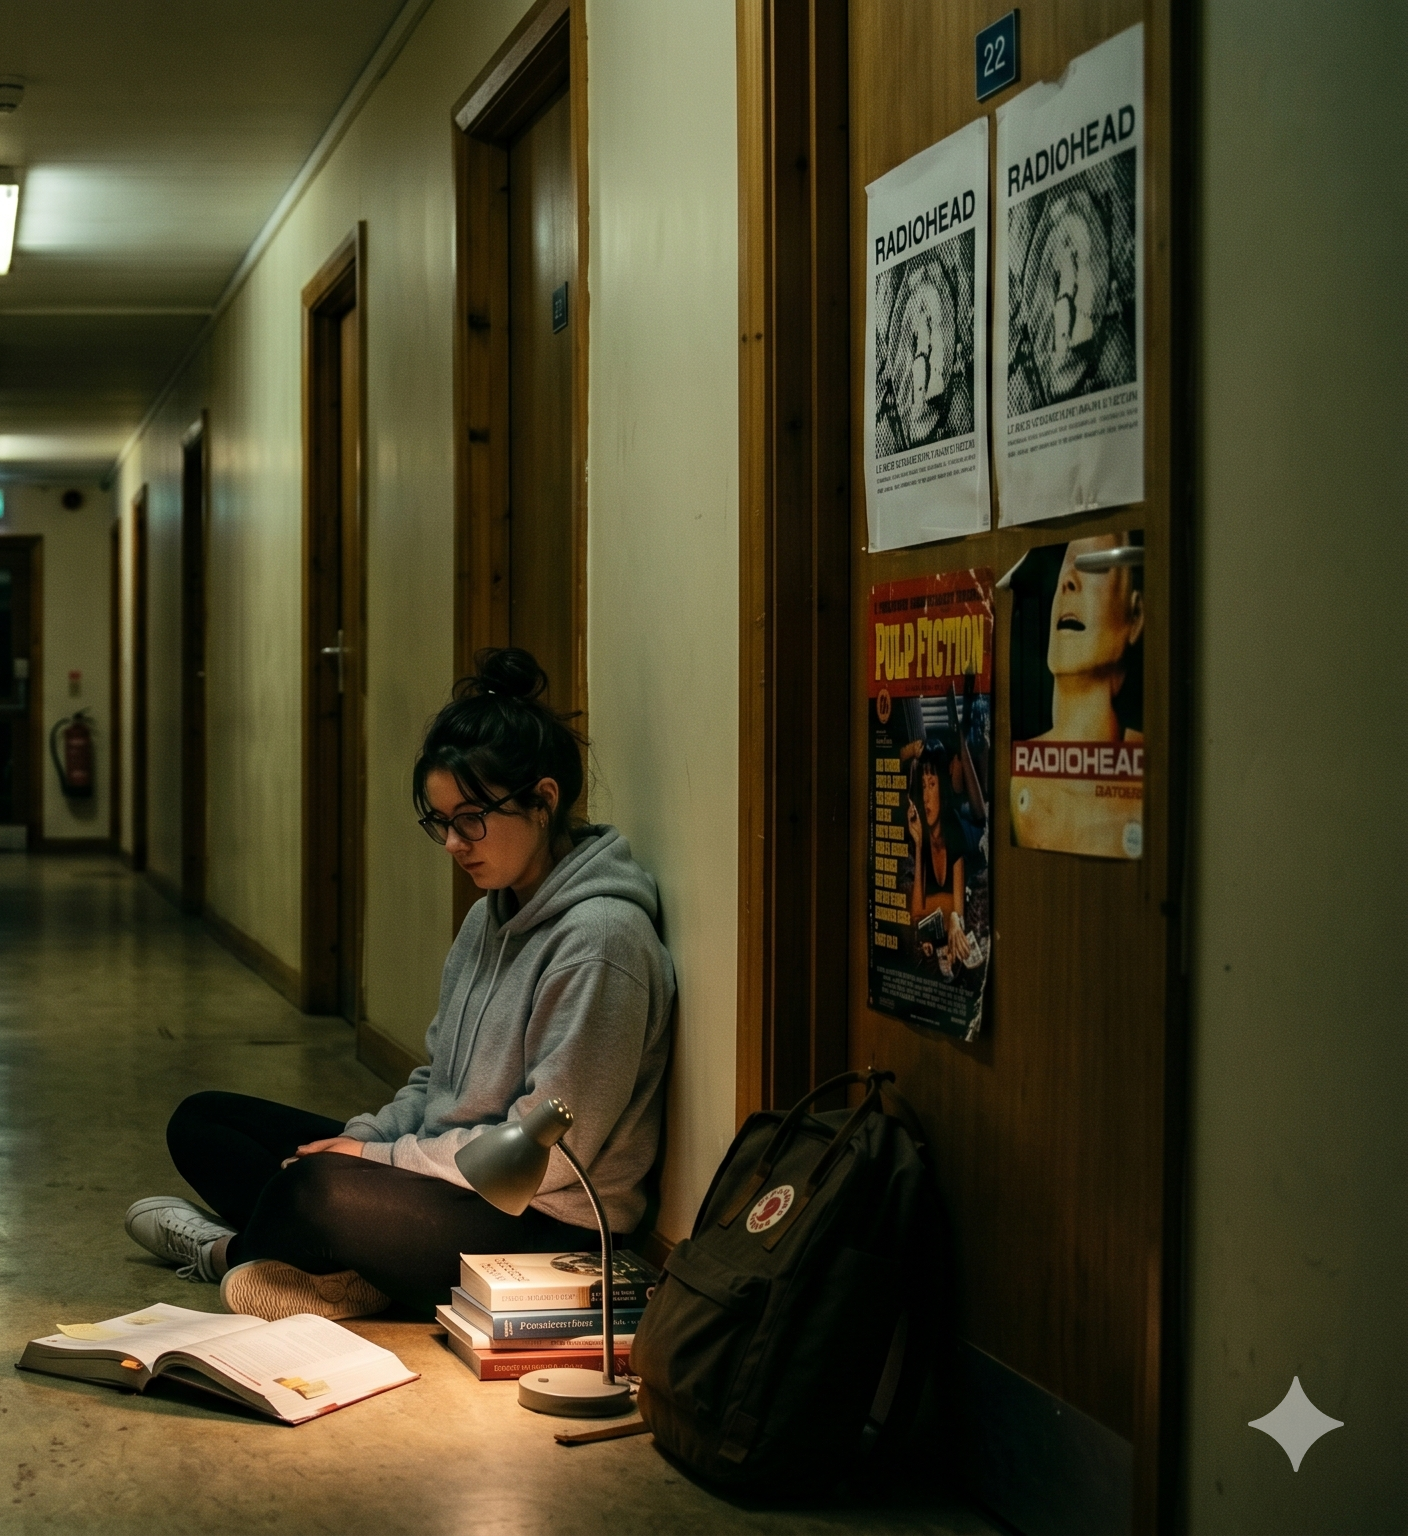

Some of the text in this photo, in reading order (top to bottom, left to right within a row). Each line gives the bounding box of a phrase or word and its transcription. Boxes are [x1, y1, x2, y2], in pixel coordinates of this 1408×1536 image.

[984, 35, 1005, 77] 22
[1008, 104, 1135, 197] RADIOHEAD
[875, 189, 975, 265] RADIOHEAD
[875, 614, 984, 680] PULP FICTION
